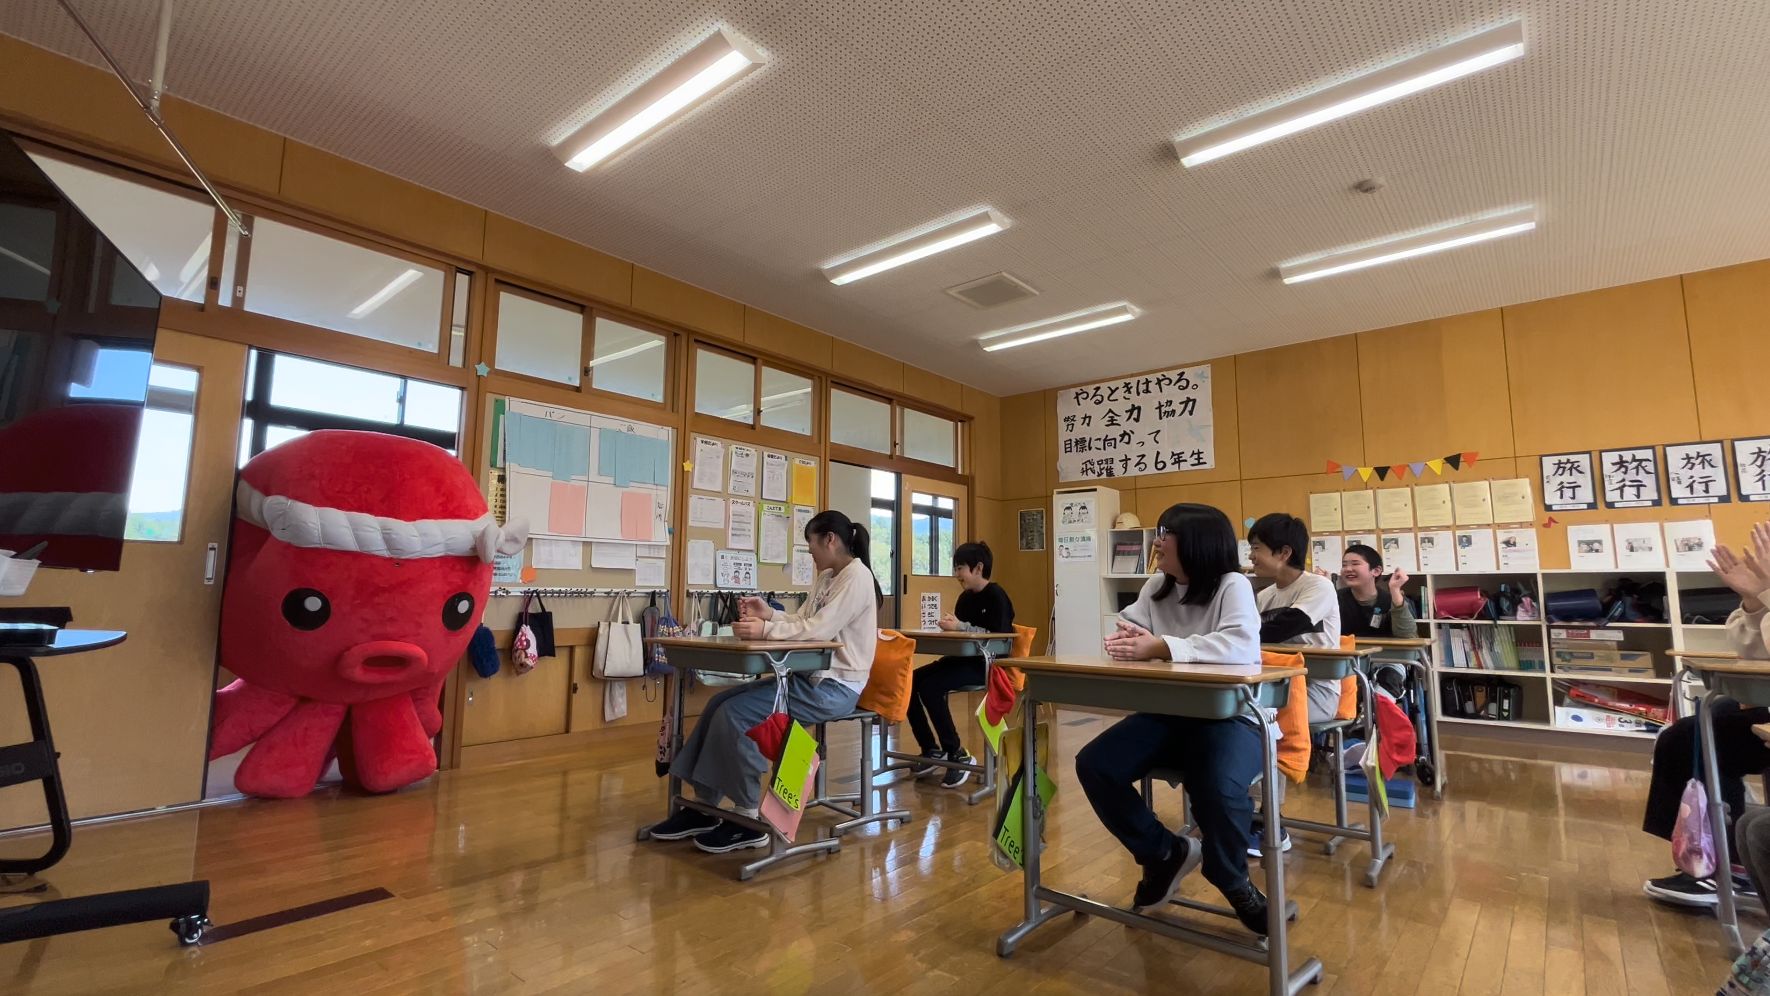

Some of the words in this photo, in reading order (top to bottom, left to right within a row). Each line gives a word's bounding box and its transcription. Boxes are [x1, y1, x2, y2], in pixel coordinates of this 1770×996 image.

[1073, 371, 1200, 406] やるときはやる。
[1063, 413, 1092, 433] 努力
[1100, 404, 1142, 428] 全力
[1155, 396, 1198, 421] 協力
[1064, 429, 1162, 454] 目標に向かって
[1080, 449, 1208, 478] 飛躍する6年生
[1551, 457, 1585, 501] 旅行
[1608, 453, 1654, 500] 旅行
[1680, 451, 1720, 496] 旅行
[775, 776, 799, 809] Tree's
